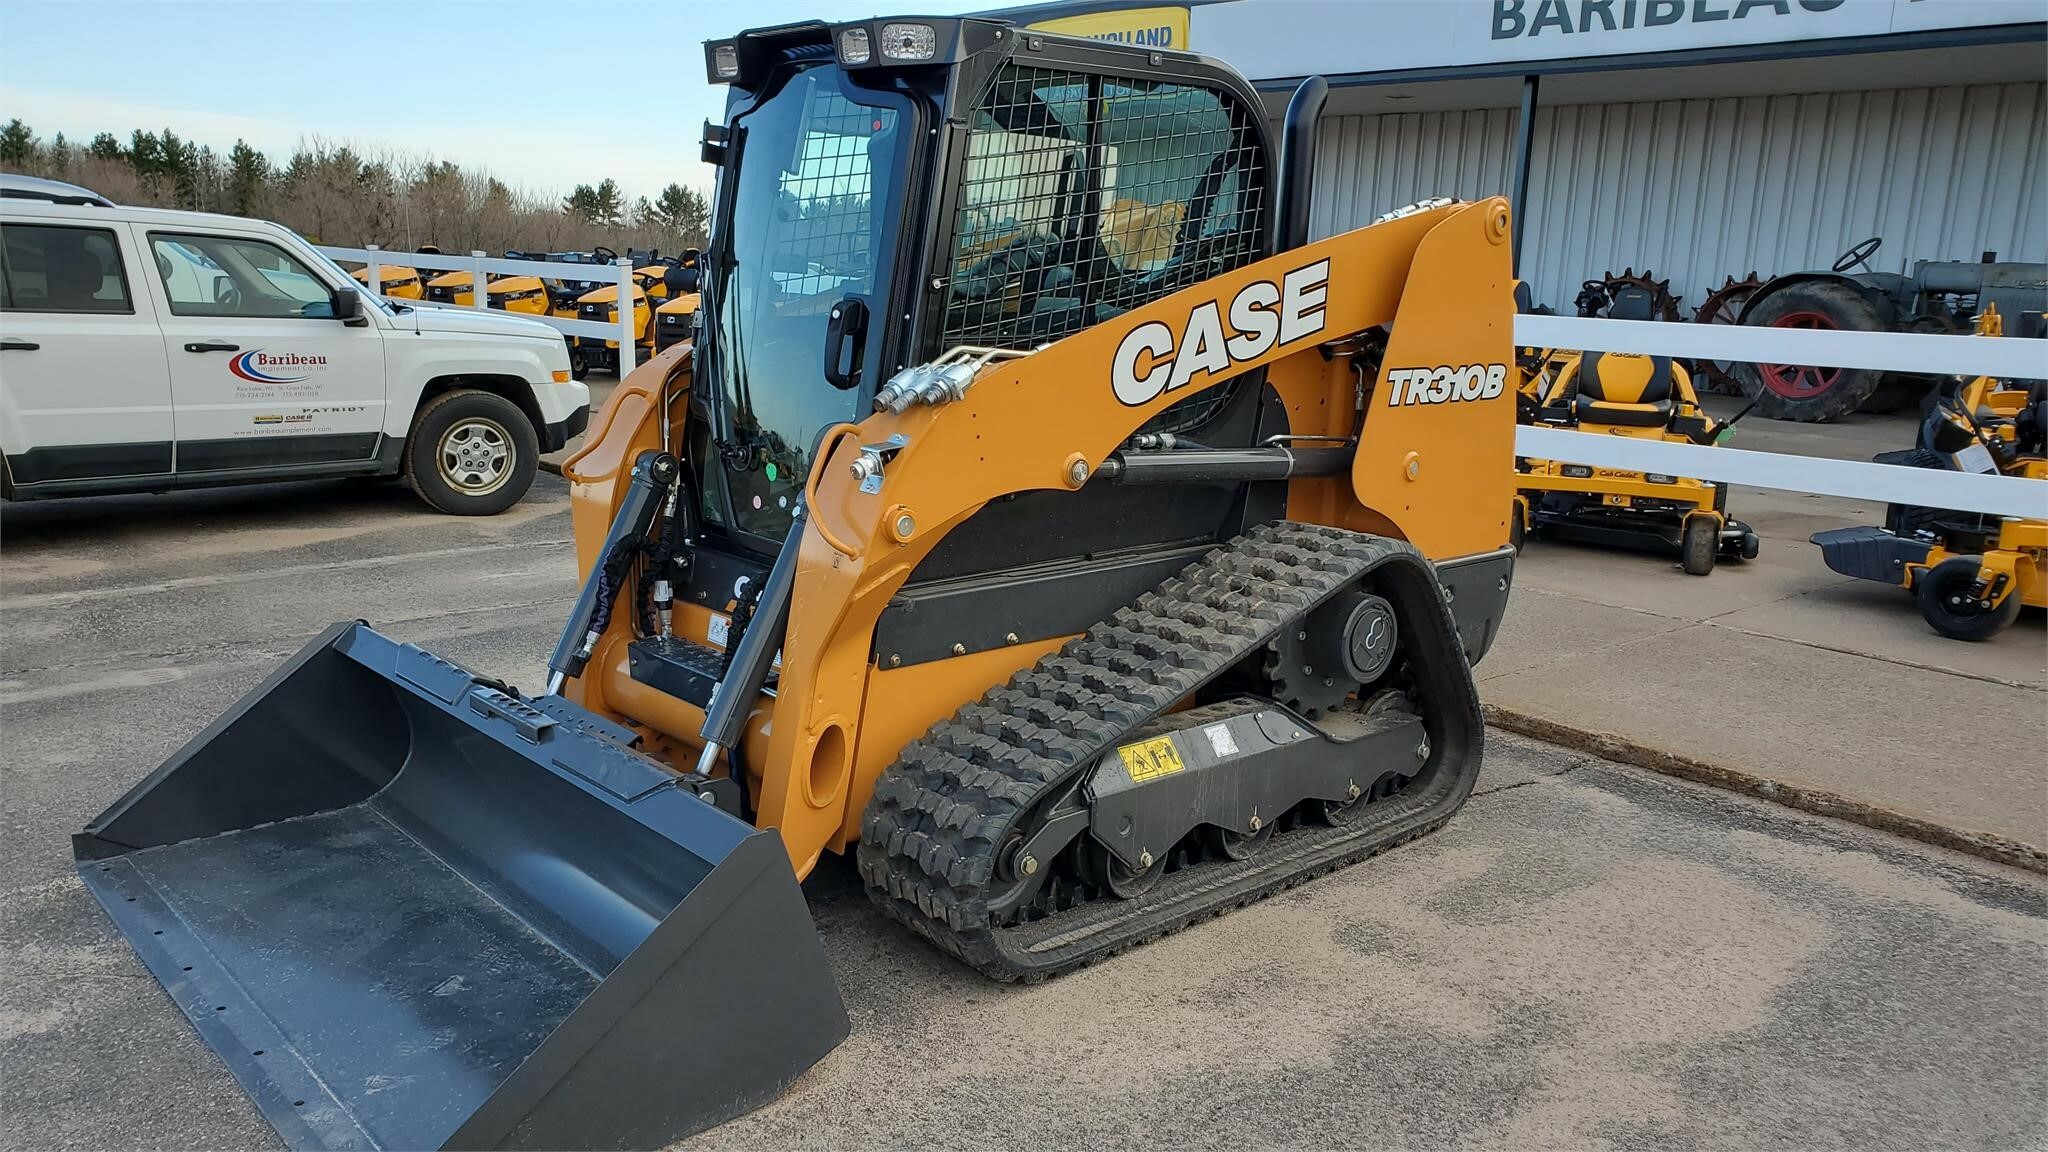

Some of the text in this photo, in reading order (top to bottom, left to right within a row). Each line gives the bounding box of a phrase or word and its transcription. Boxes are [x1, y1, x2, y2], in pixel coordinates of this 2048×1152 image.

[1491, 0, 1845, 40] BARIB
[1110, 257, 1331, 407] CASE
[258, 353, 327, 365] Baribeau
[1387, 364, 1507, 407] TR310B
[1614, 471, 1638, 479] Cadet
